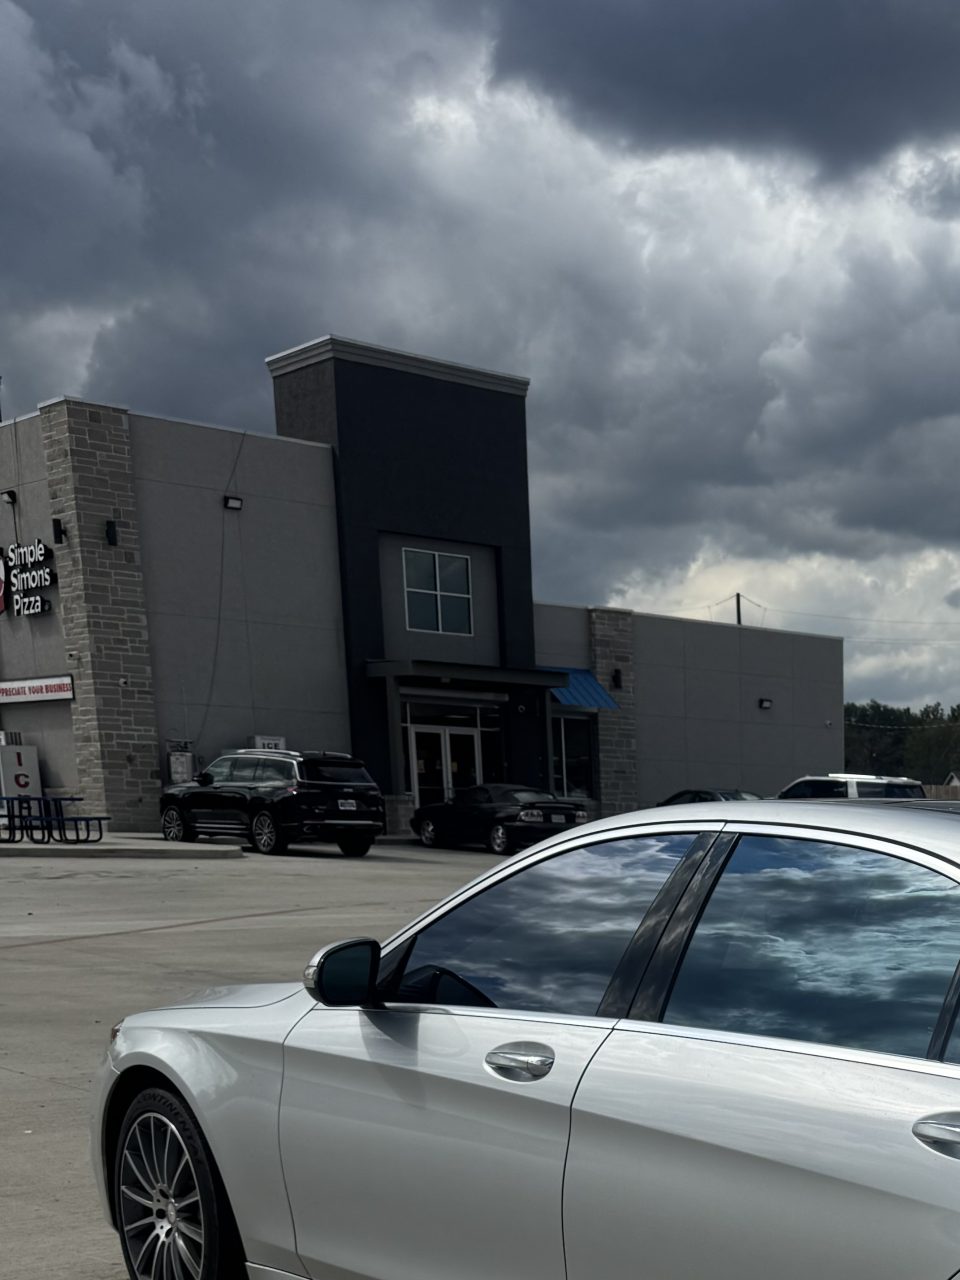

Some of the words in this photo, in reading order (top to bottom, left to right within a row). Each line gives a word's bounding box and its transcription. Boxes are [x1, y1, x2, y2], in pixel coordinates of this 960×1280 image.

[8, 538, 45, 568] Simple
[10, 566, 51, 592] Simon's
[13, 593, 41, 616] Pizza
[28, 685, 44, 695] YOUR
[45, 683, 72, 694] BUSINESS
[262, 742, 281, 750] ICE
[14, 751, 31, 798] IC
